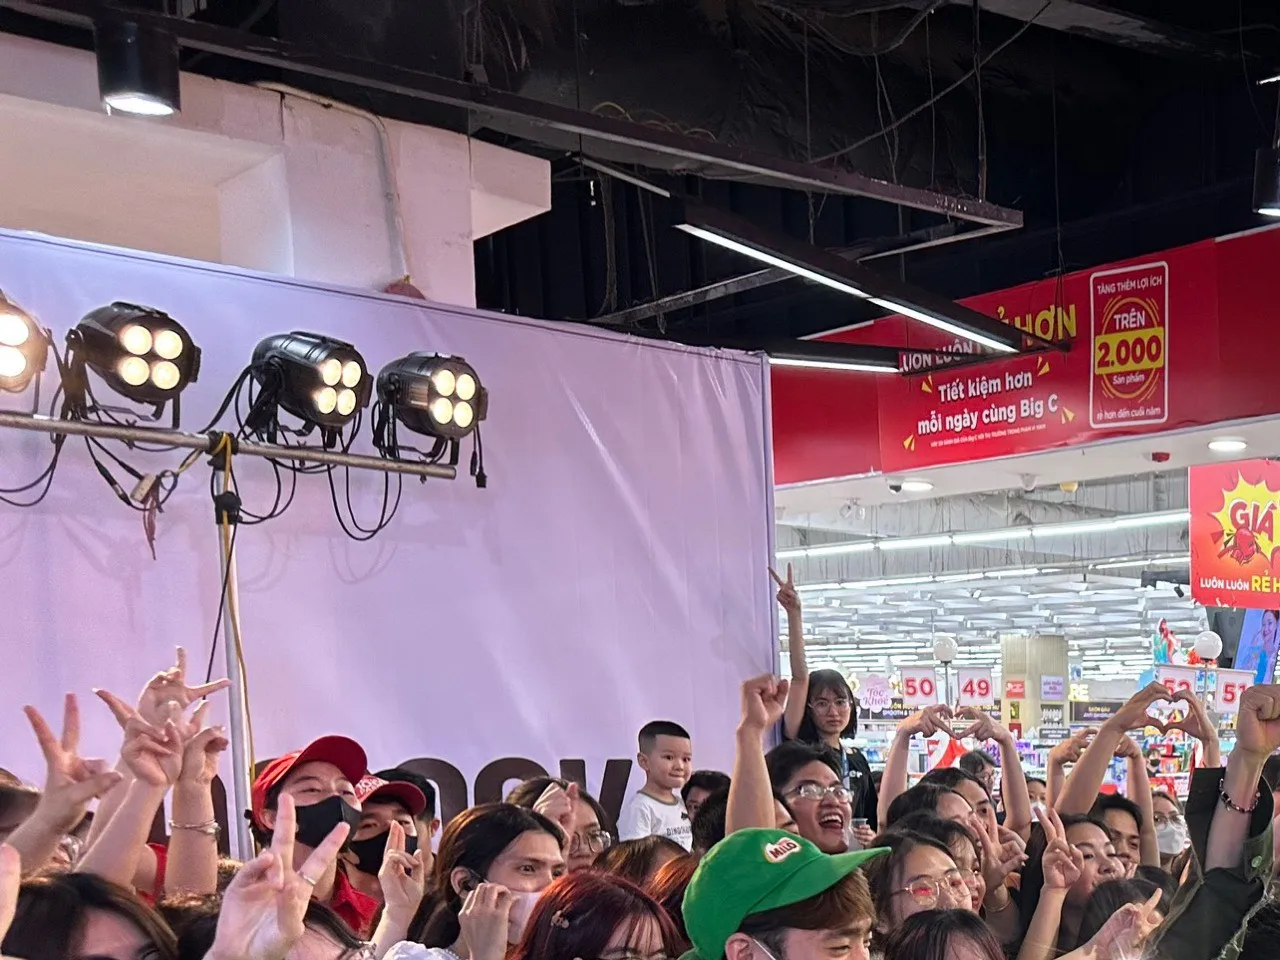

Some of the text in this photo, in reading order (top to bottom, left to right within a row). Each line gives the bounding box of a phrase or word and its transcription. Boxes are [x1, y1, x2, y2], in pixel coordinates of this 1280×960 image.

[1113, 307, 1147, 331] TRÊN
[1097, 334, 1163, 370] 2.000
[937, 371, 1034, 403] Tiết kiệm hơn
[917, 409, 943, 436] mỗi
[945, 407, 979, 432] ngày
[981, 400, 1018, 427] cùng
[1020, 398, 1045, 419] Big
[1047, 393, 1059, 413] C
[1228, 497, 1278, 544] GIÁ
[1200, 575, 1225, 589] LUÔN
[1225, 577, 1250, 592] LUÔN
[1251, 568, 1272, 593] RẺ
[867, 687, 886, 698] Tóc
[905, 676, 934, 696] 50
[962, 679, 990, 697] 49
[1223, 682, 1249, 704] 51
[769, 841, 798, 859] MILO
